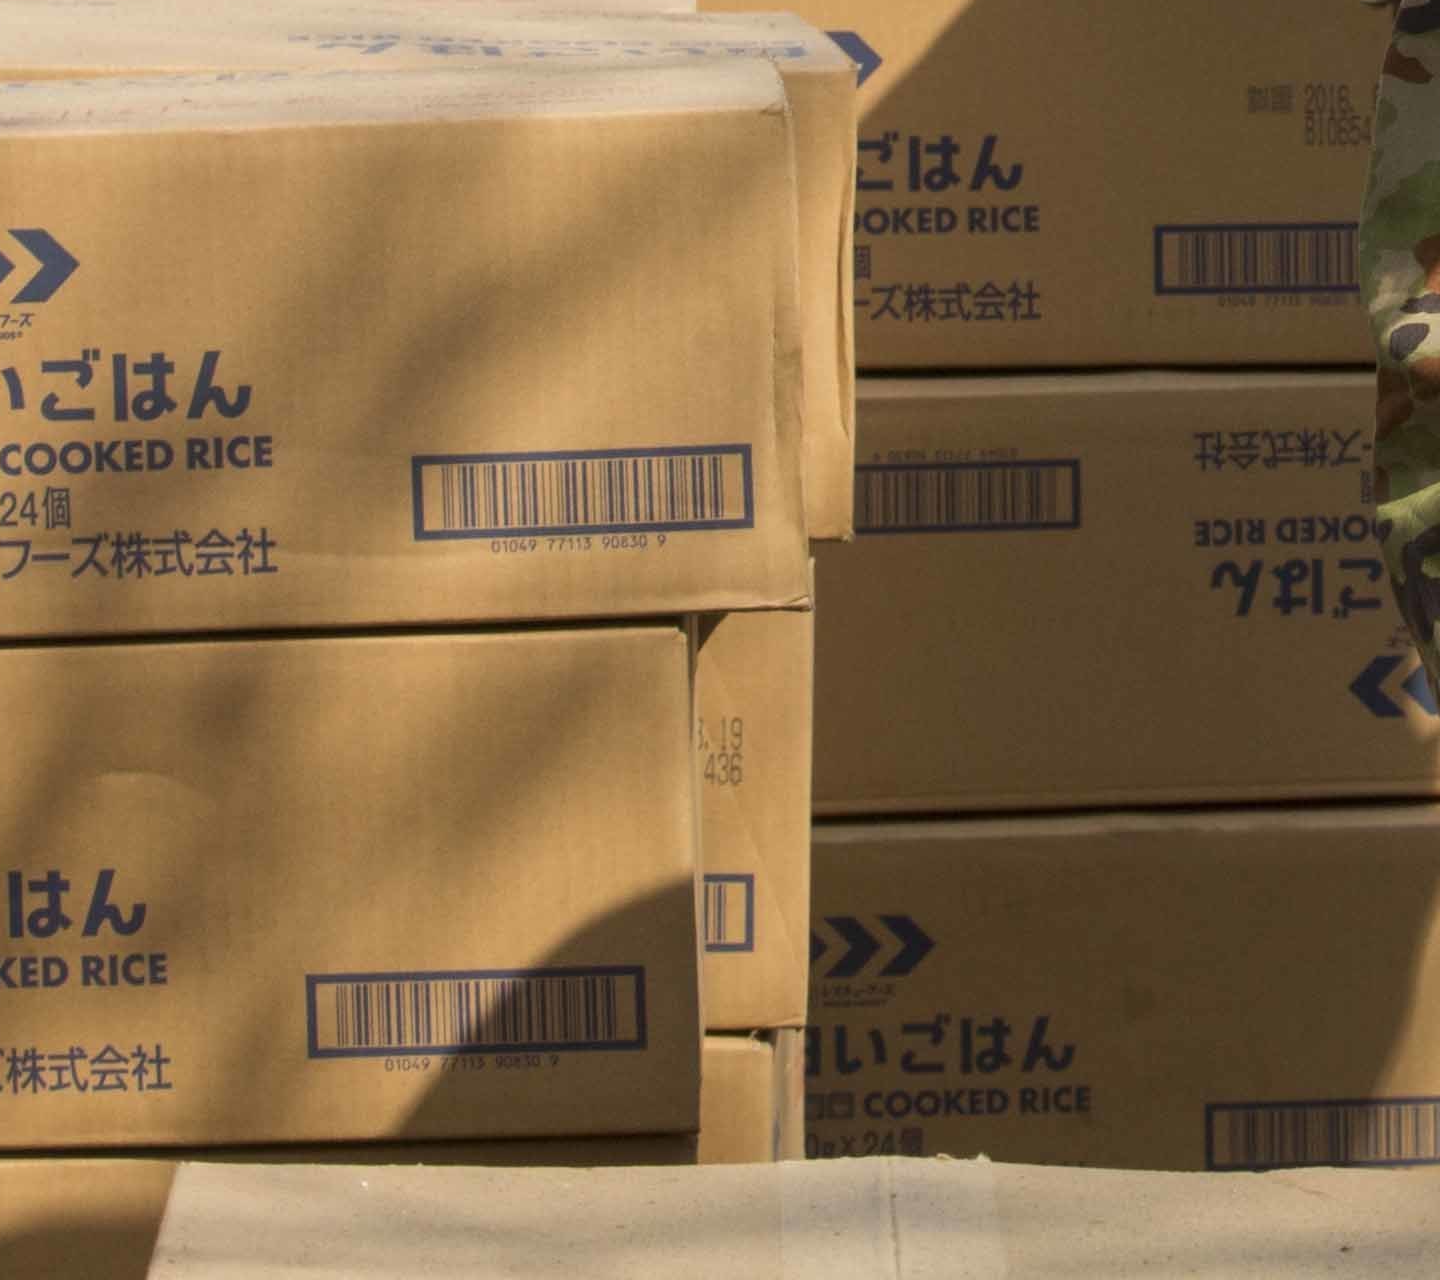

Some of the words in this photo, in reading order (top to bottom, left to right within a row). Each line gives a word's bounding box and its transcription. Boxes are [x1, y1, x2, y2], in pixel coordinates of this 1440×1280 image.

[854, 207, 957, 235] OKED
[967, 205, 1041, 232] RICE
[187, 434, 273, 471] RICE
[1193, 519, 1266, 547] RICE
[1275, 514, 1378, 545] OKED
[81, 952, 168, 987] RICE
[864, 1088, 1010, 1120] COOKED
[1019, 1084, 1092, 1114] RICE
